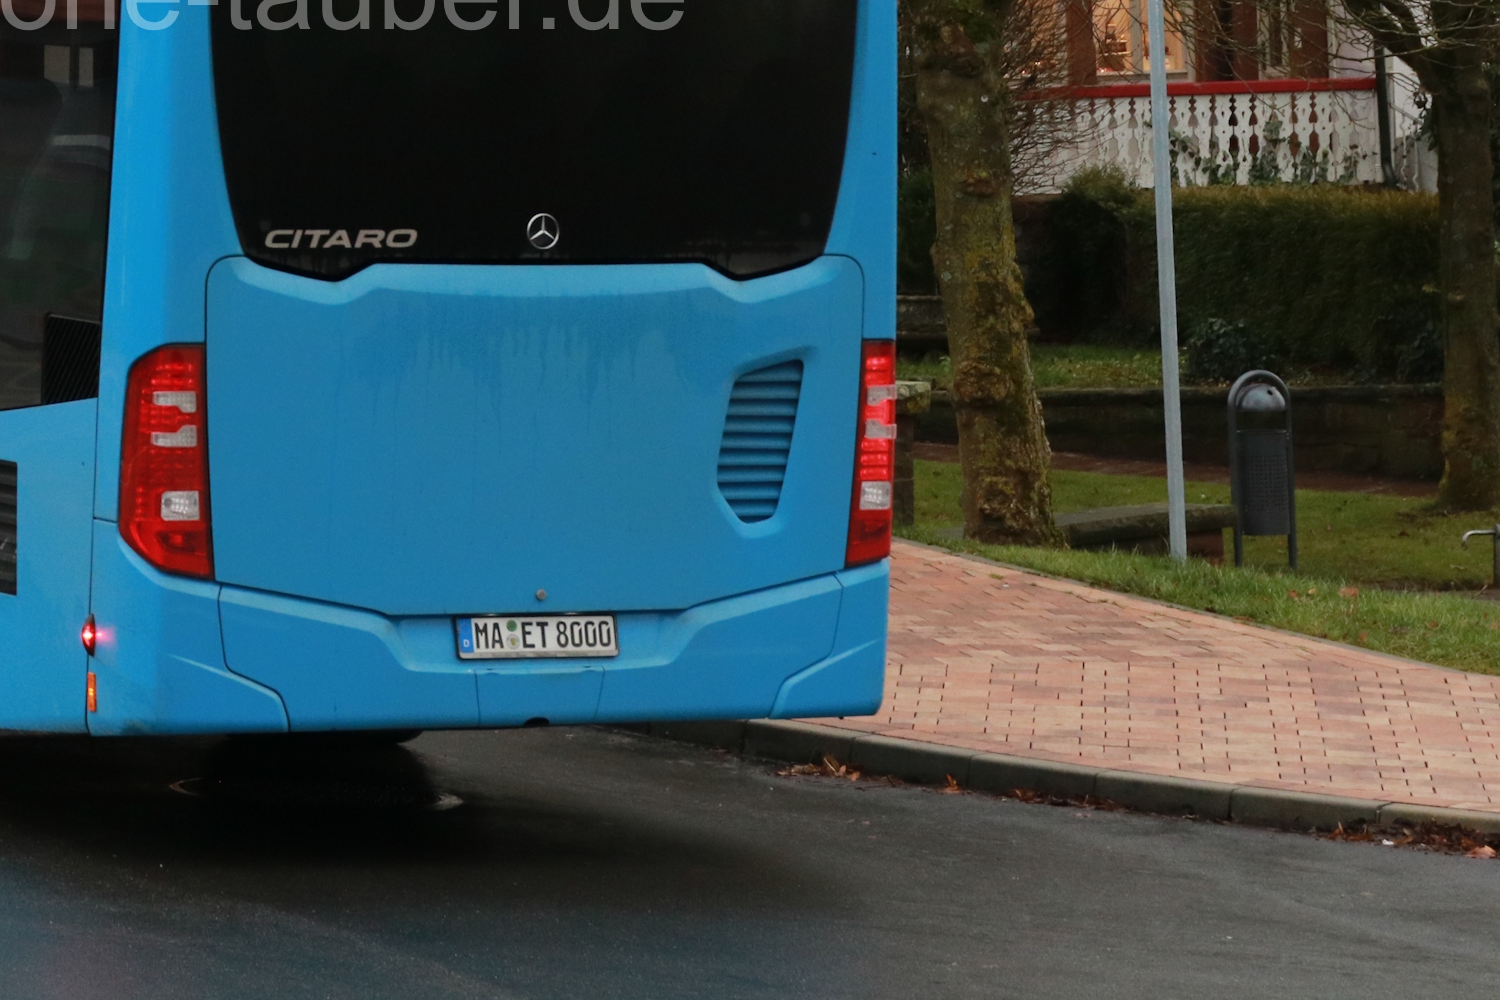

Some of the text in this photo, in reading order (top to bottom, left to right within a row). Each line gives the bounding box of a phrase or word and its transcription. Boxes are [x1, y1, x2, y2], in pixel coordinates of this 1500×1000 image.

[264, 228, 418, 249] CITARO
[474, 620, 612, 649] MA ET 8000
